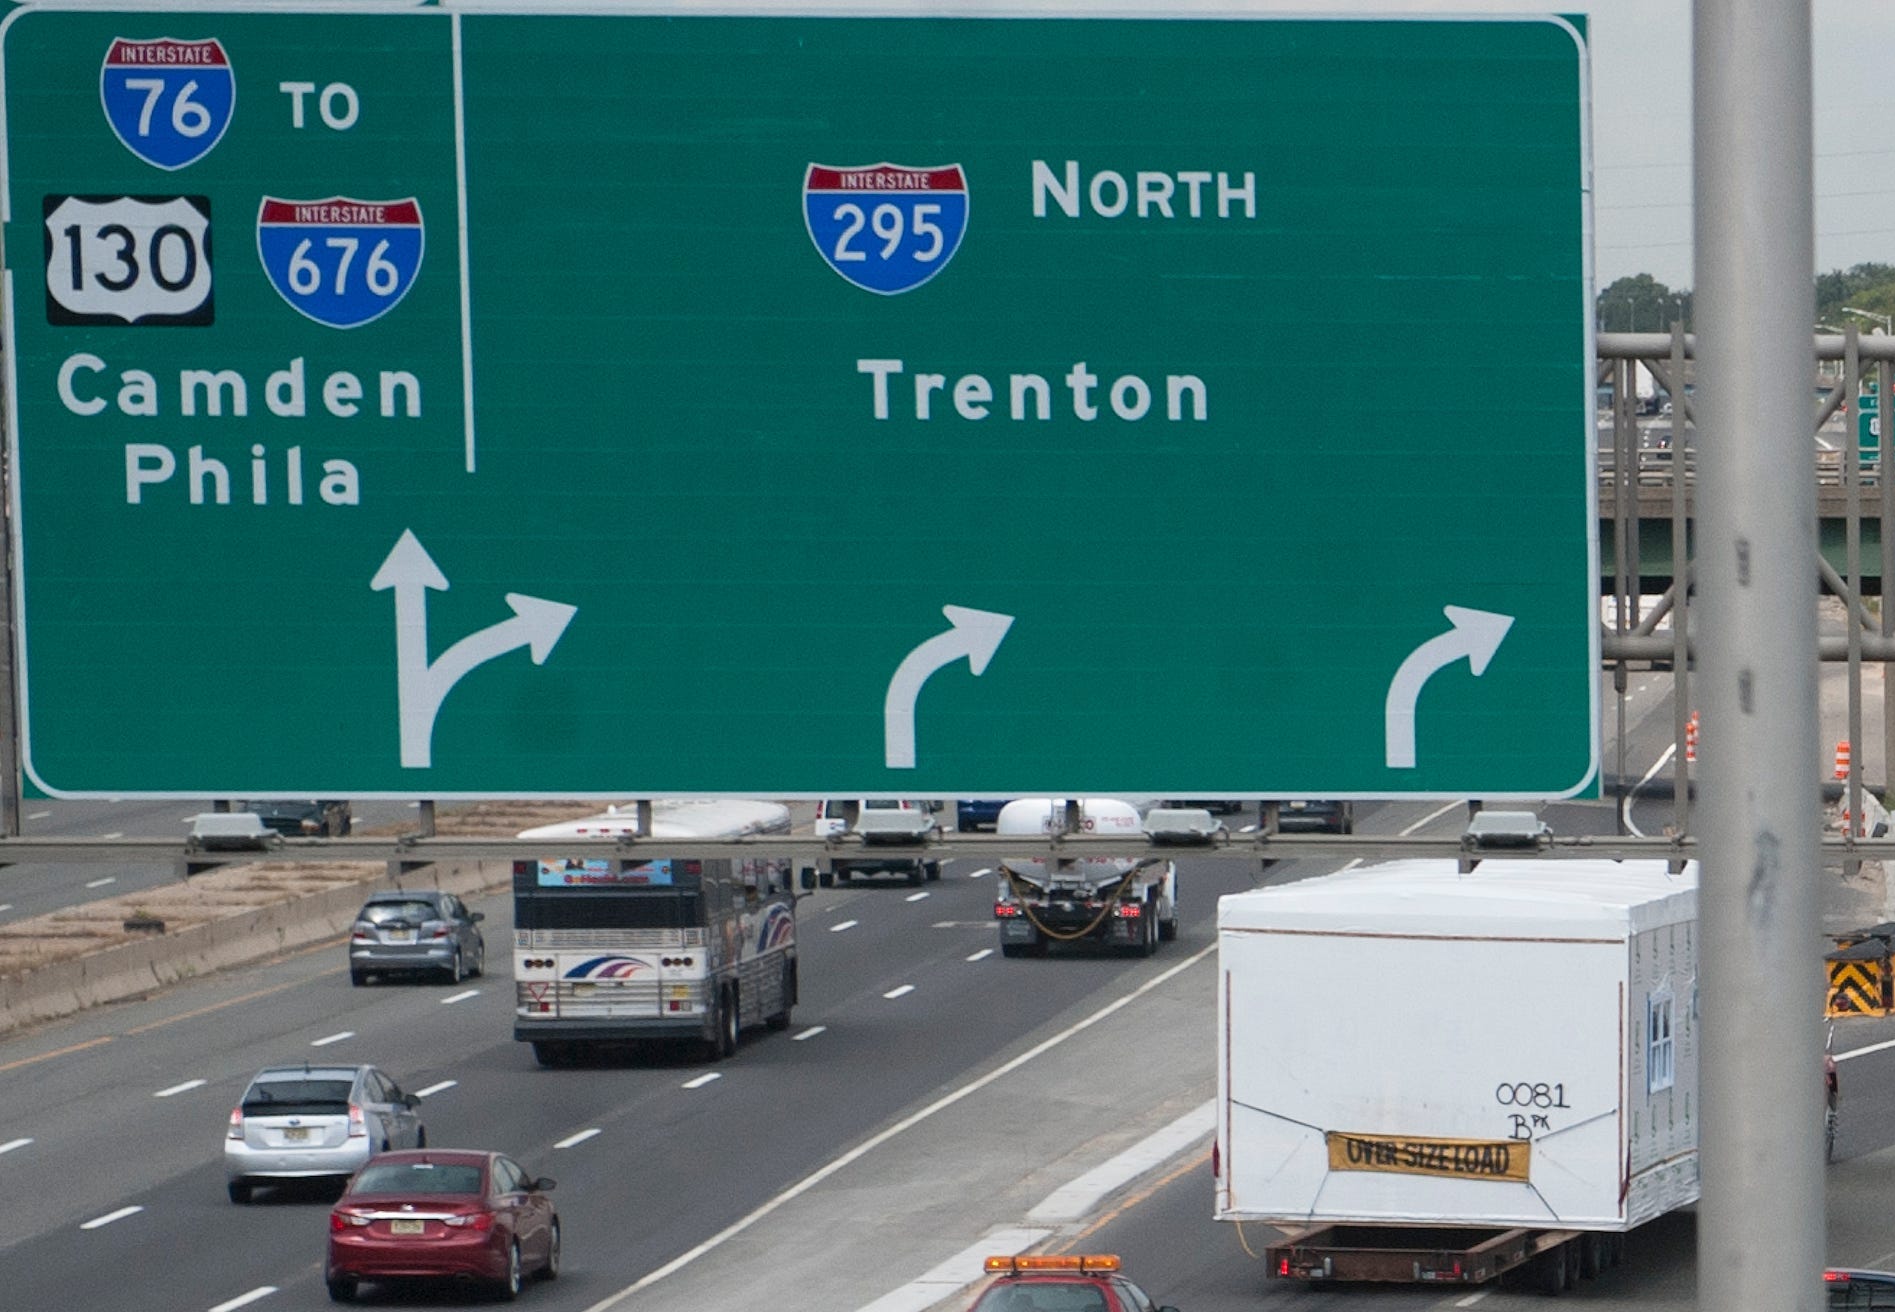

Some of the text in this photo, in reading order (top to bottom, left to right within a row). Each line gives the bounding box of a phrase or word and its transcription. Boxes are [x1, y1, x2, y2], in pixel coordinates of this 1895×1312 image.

[119, 45, 212, 65] INTERSTATE
[125, 78, 360, 139] 76 TO
[840, 172, 930, 190] INTERSTATE
[1031, 159, 1257, 219] NORTH
[294, 204, 386, 224] INTERSTATE
[833, 202, 944, 262] 295
[61, 223, 401, 297] 130 676
[57, 353, 423, 418] Camden
[857, 358, 1209, 422] Trenton
[125, 443, 362, 507] Phila
[1496, 1082, 1571, 1109] 0081
[1346, 1138, 1510, 1175] OVER SIZE LOAD
